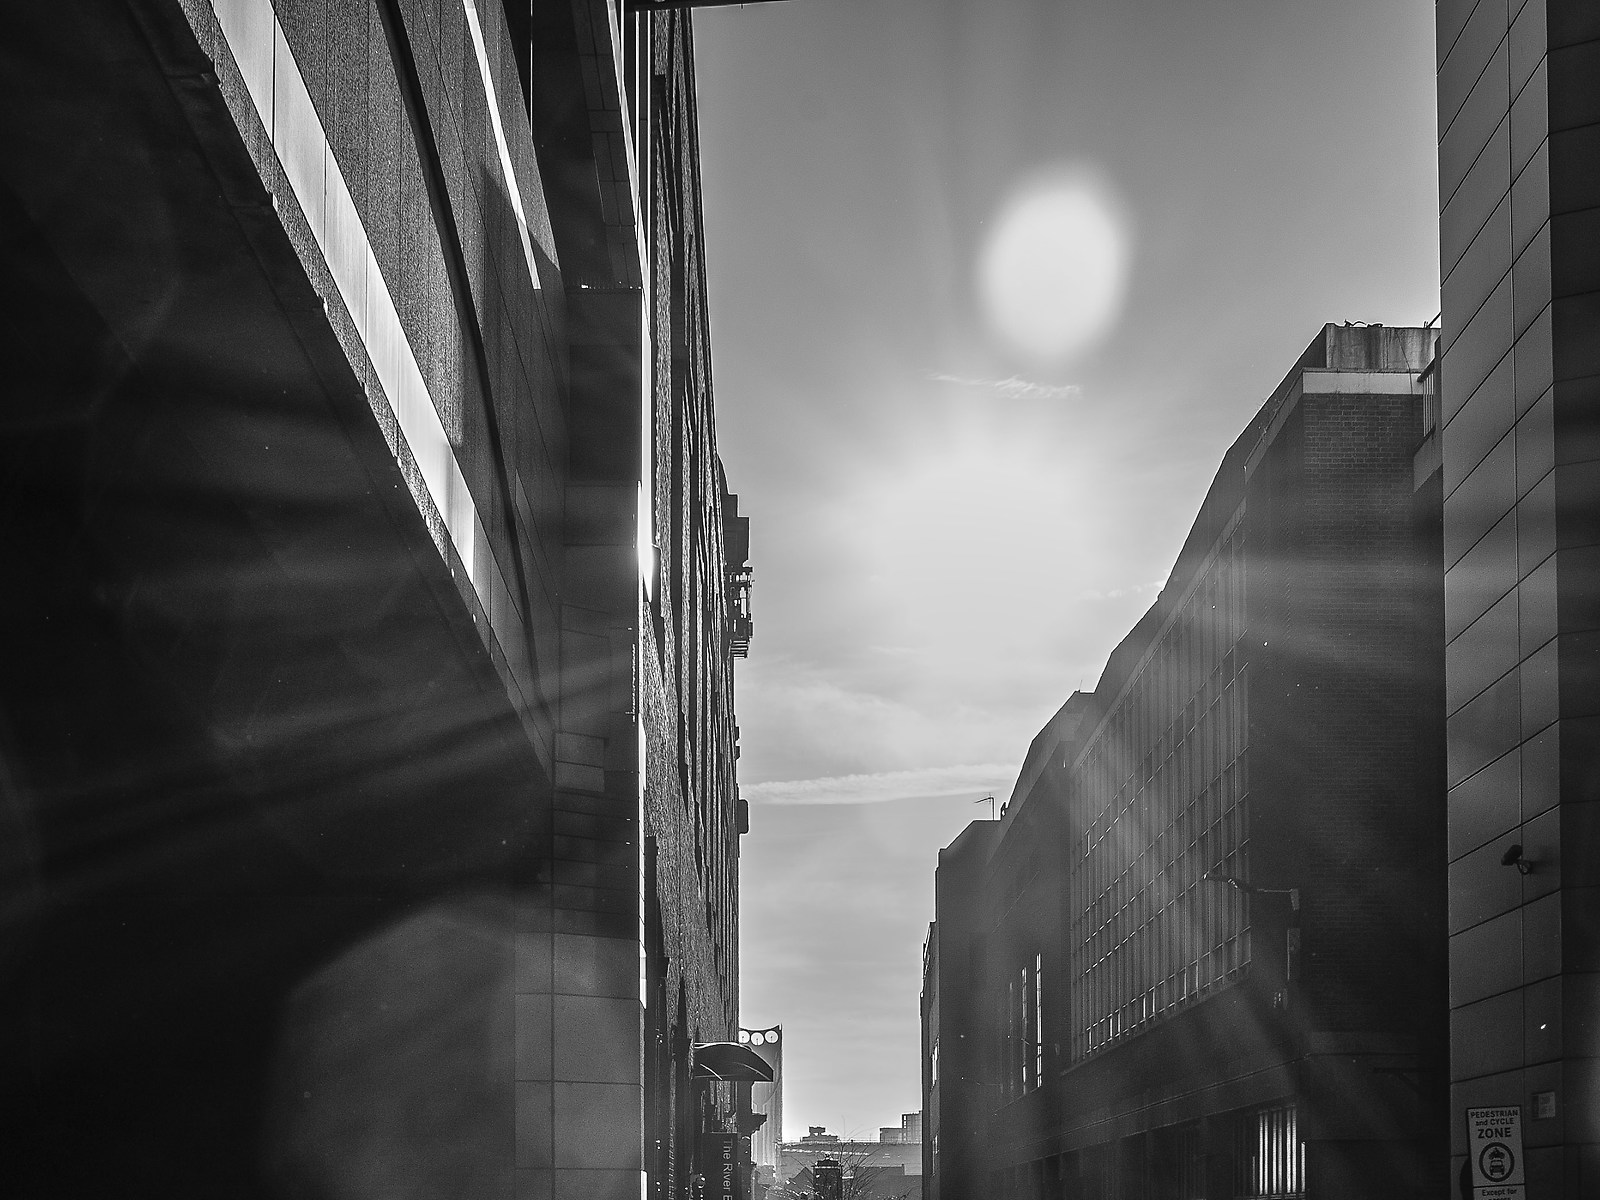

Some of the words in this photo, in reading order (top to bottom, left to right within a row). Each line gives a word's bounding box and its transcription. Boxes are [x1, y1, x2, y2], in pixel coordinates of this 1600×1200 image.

[1470, 1110, 1519, 1118] PEDESTRIAN
[1490, 1117, 1515, 1126] CYCLE
[1478, 1127, 1512, 1139] ZONE
[722, 1139, 733, 1160] The
[722, 1163, 733, 1192] River
[1481, 1188, 1506, 1197] Except
